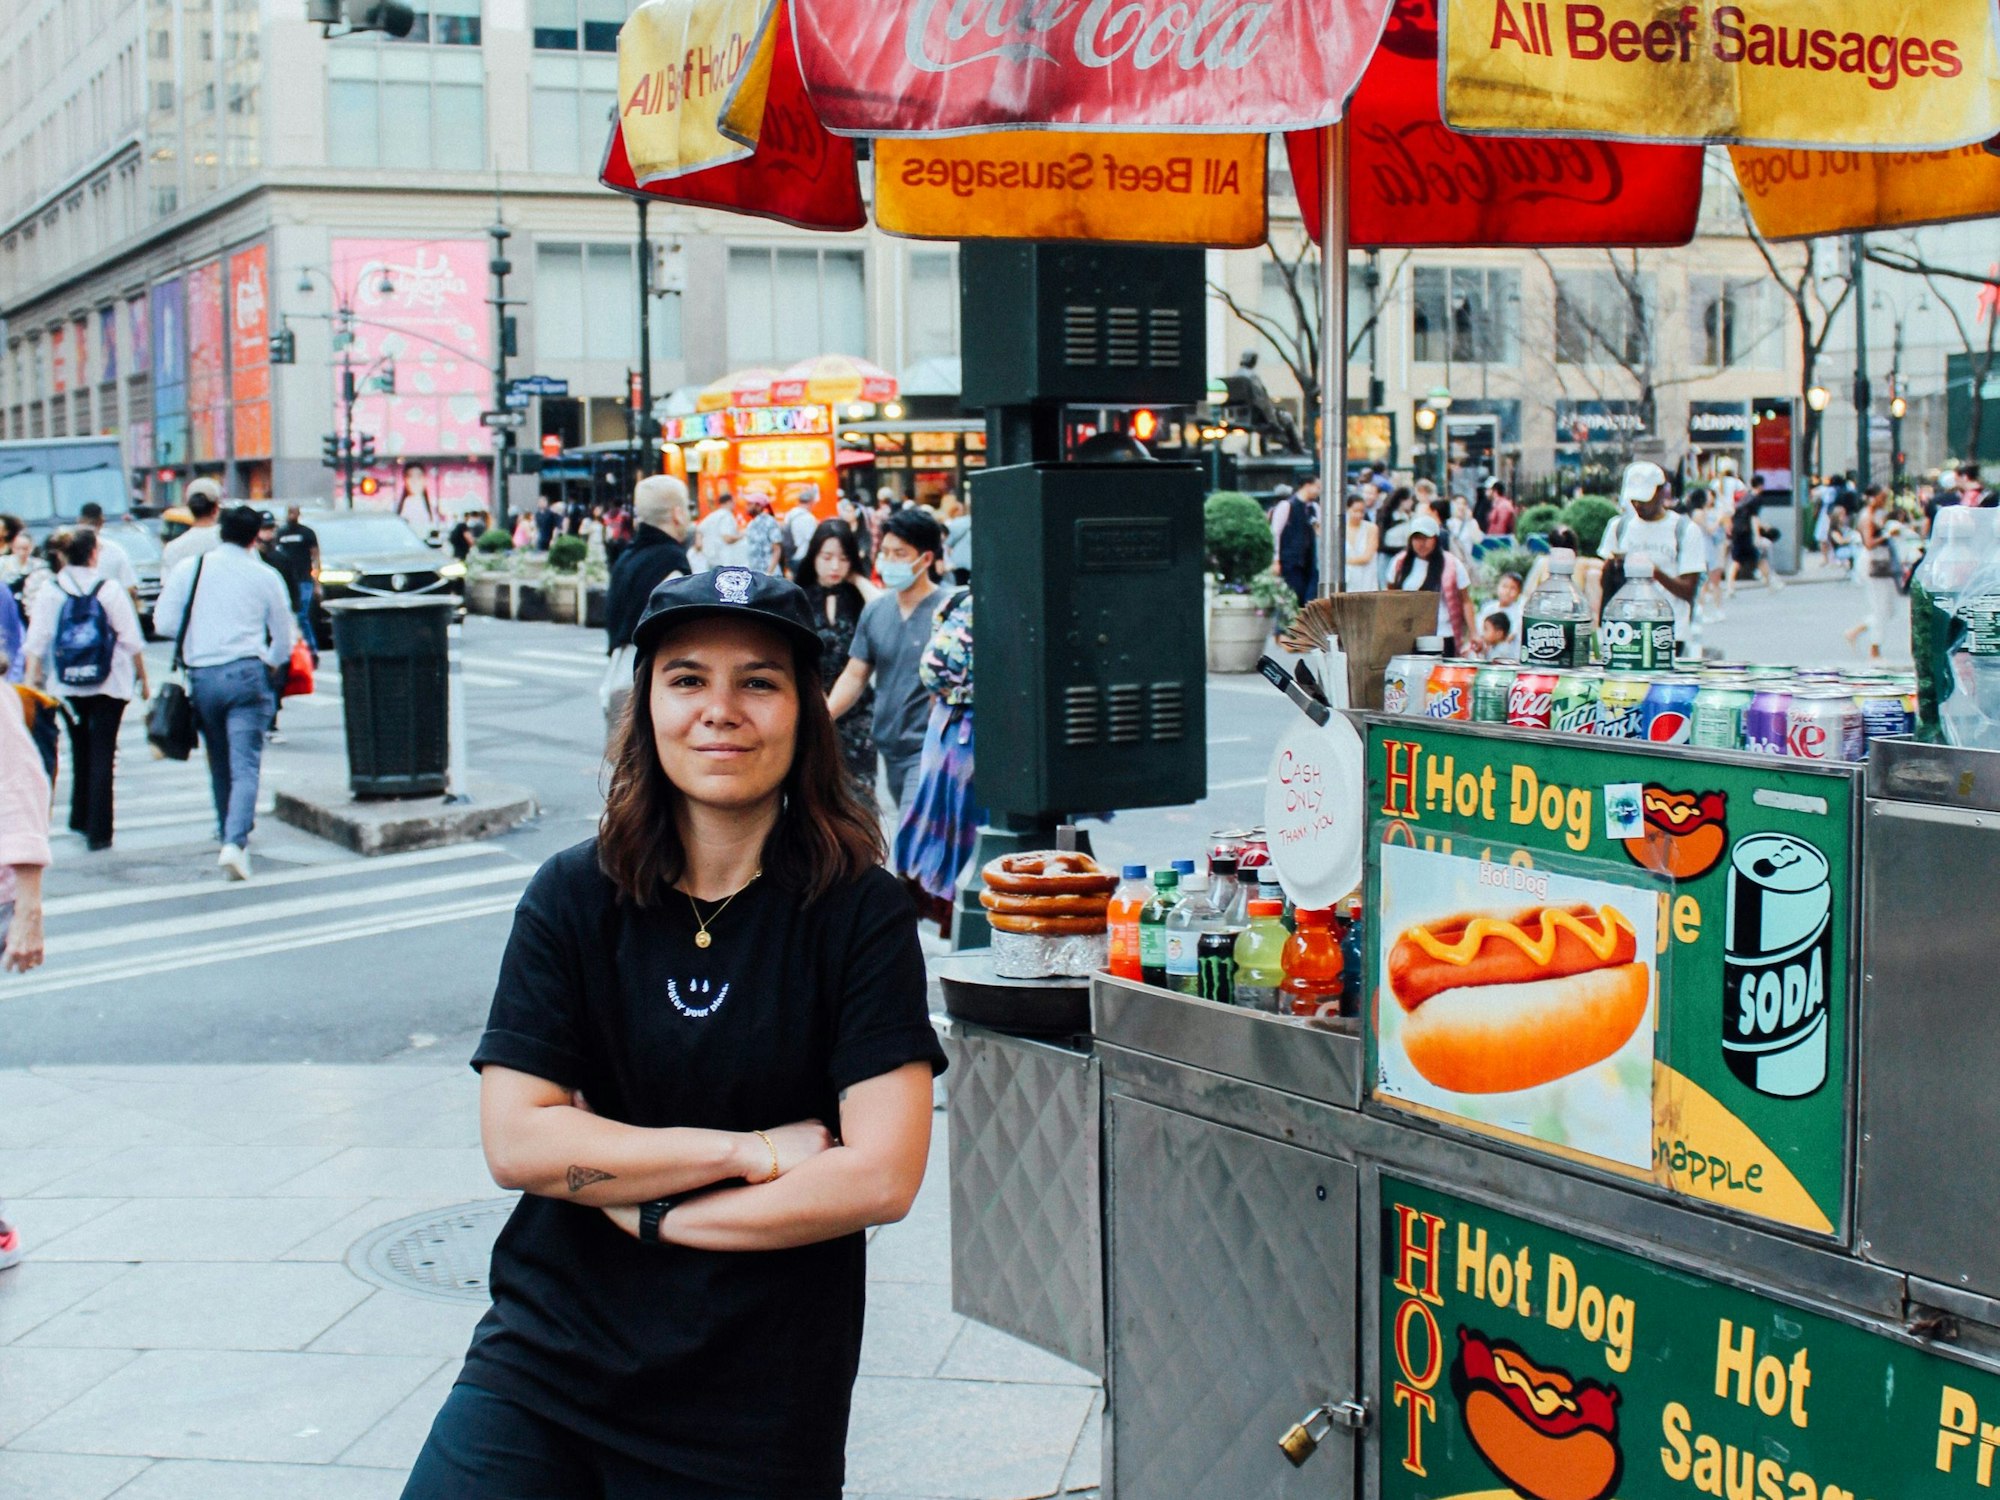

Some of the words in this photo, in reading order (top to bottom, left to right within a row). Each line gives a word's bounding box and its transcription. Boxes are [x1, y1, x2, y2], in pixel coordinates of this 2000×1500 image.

[1490, 2, 1553, 57] All
[1566, 5, 1697, 63] Beef
[1713, 6, 1963, 90] Sausages
[624, 73, 664, 118] All
[1426, 755, 1496, 821] Hot
[1510, 764, 1592, 851] Dog
[1480, 862, 1510, 889] Hot
[1513, 866, 1549, 900] Dog
[1738, 946, 1824, 1036] SODA
[1393, 1203, 1446, 1478] HOT
[1456, 1221, 1532, 1317] Hot
[1546, 1253, 1635, 1373] Dog
[1714, 1317, 1811, 1428] Hot
